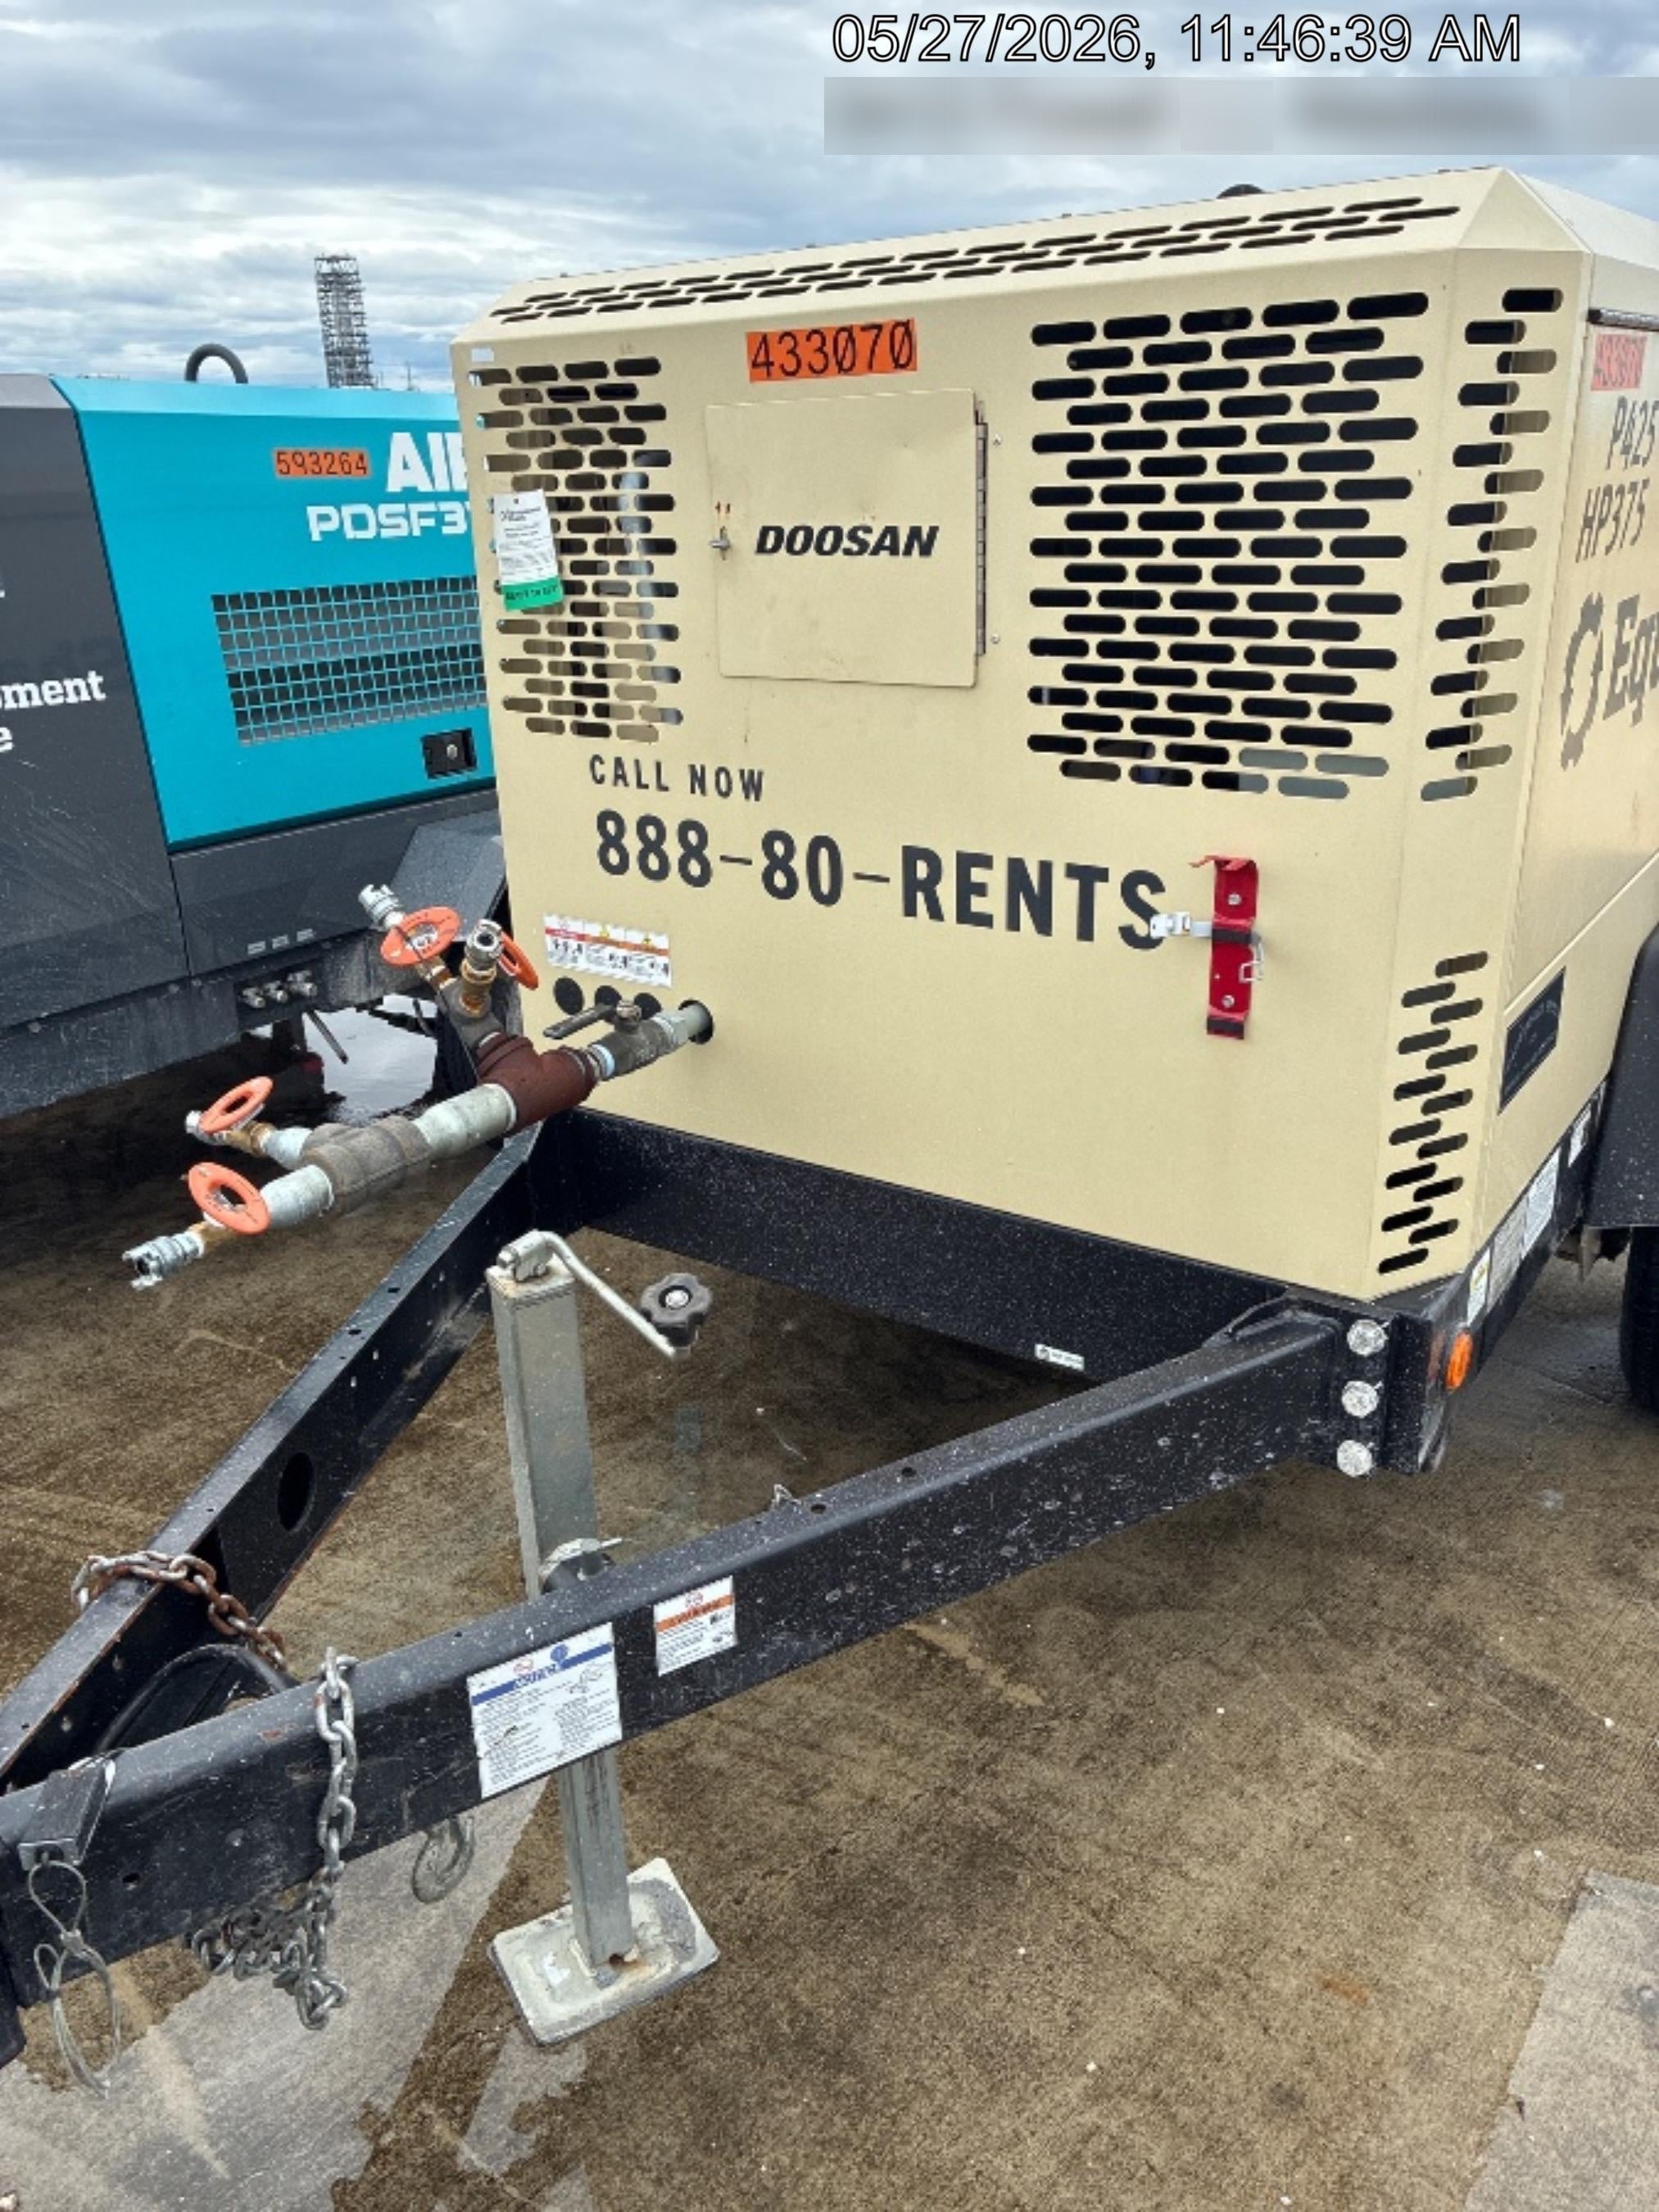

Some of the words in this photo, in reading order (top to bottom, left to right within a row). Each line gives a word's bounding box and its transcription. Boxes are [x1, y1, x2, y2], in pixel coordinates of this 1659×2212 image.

[750, 319, 915, 378] 433070
[277, 451, 367, 476] 593264
[306, 500, 470, 542] PDSF3
[755, 524, 939, 557] DOOSAN
[1575, 477, 1650, 562] HP375
[0, 670, 107, 711] ment
[588, 755, 670, 793] CALL
[689, 763, 764, 802] NOW
[595, 808, 1167, 951] 888-80-RENTS
